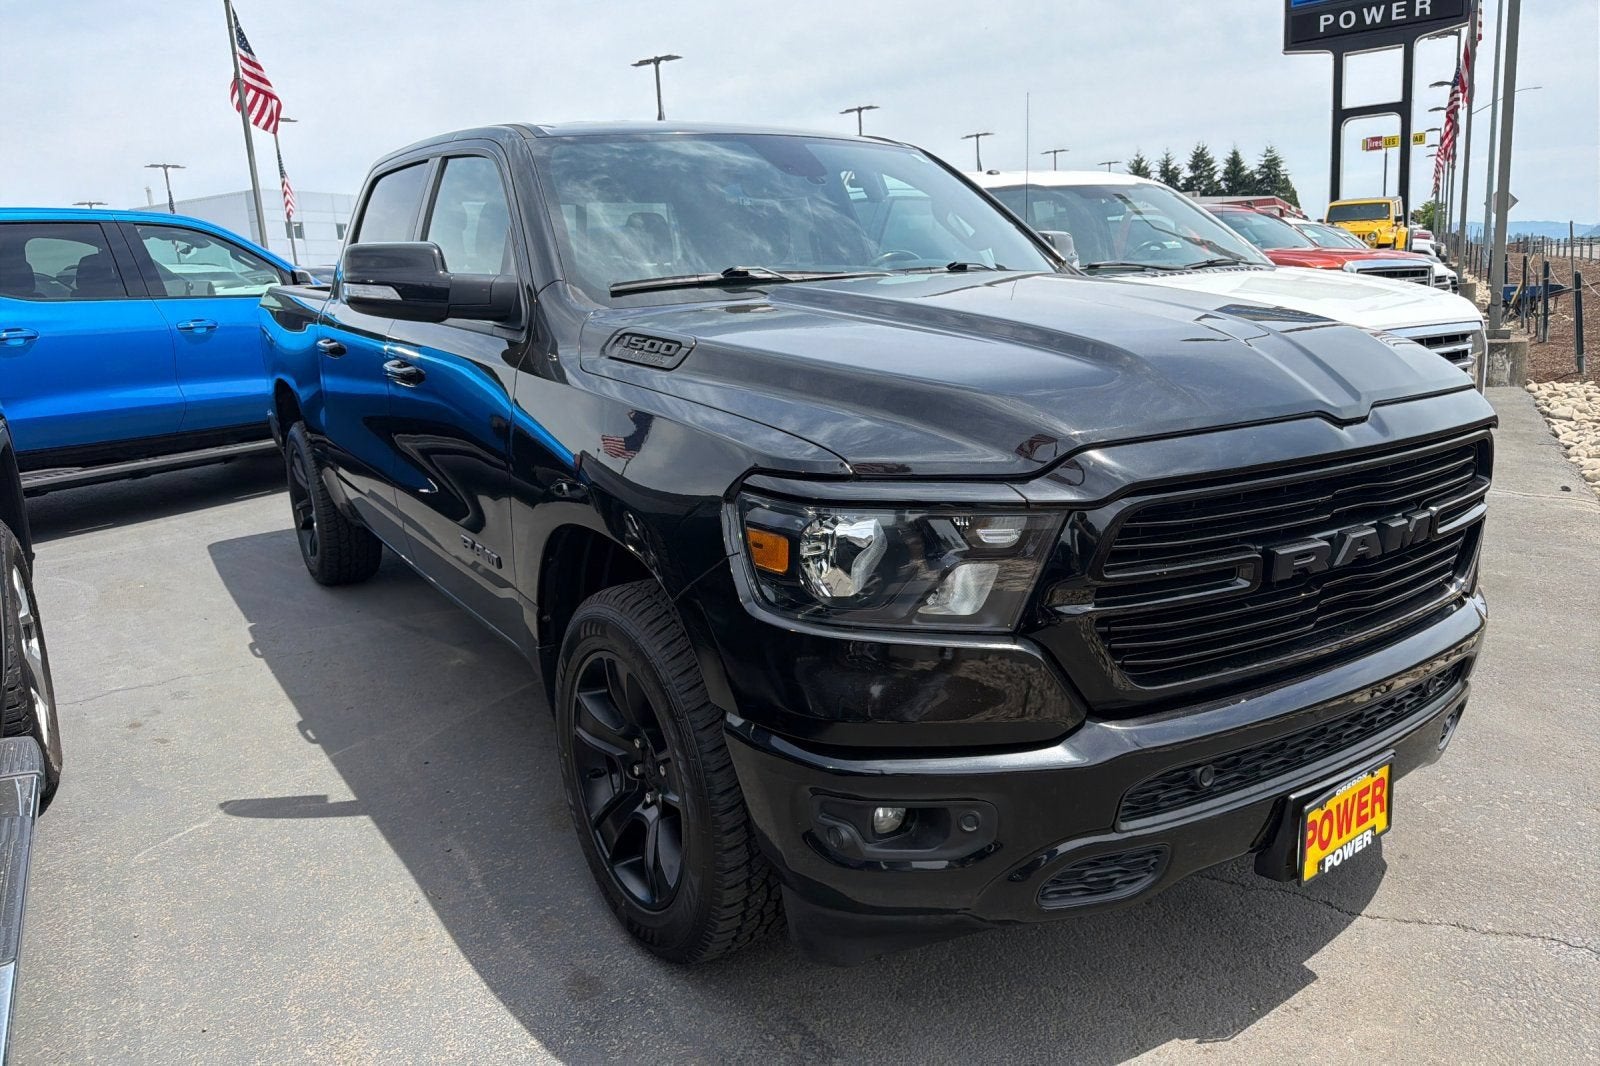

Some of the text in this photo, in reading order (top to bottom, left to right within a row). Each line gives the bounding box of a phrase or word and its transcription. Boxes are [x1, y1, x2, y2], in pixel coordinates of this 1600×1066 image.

[1319, 0, 1431, 33] POWER
[1367, 138, 1383, 149] Tires
[1384, 138, 1396, 146] LES
[621, 335, 680, 356] 1500
[1268, 511, 1432, 584] RAM
[1305, 776, 1386, 851] POWER
[1324, 829, 1372, 873] POWER
